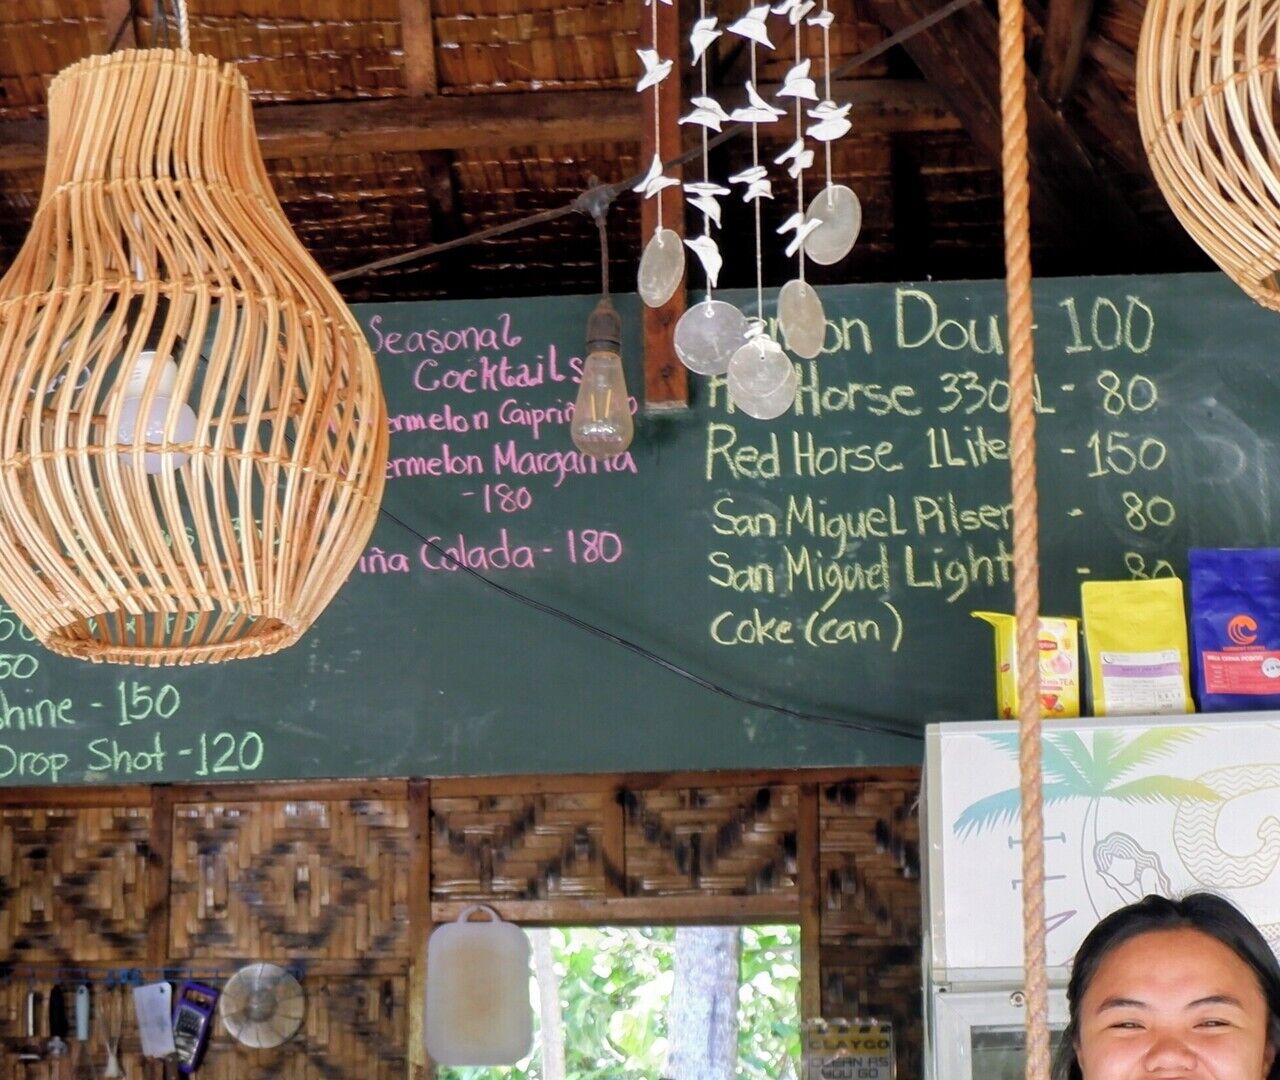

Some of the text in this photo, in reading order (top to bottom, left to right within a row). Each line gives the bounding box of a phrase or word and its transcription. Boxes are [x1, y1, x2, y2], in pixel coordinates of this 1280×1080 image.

[370, 313, 522, 354] Seasonal
[1060, 295, 1155, 354] 100
[414, 345, 586, 393] Cocktails
[795, 362, 922, 416] Horse
[939, 373, 1055, 414] 330L
[1096, 370, 1158, 415] 80
[706, 422, 779, 479] Red
[793, 431, 904, 477] Horse
[926, 426, 1015, 469] 1Lite
[711, 497, 777, 537] San
[1123, 491, 1176, 532] 80
[420, 528, 536, 571] Colada
[708, 551, 775, 593] San
[786, 545, 890, 611] Miguel
[907, 540, 1017, 602] Light
[709, 607, 796, 650] Coke
[117, 680, 181, 726] 150
[87, 738, 167, 775] Shot
[810, 1038, 889, 1051] CLAYGO
[811, 1056, 889, 1068] CLEAN AS
[821, 1067, 879, 1079] YOU GO
